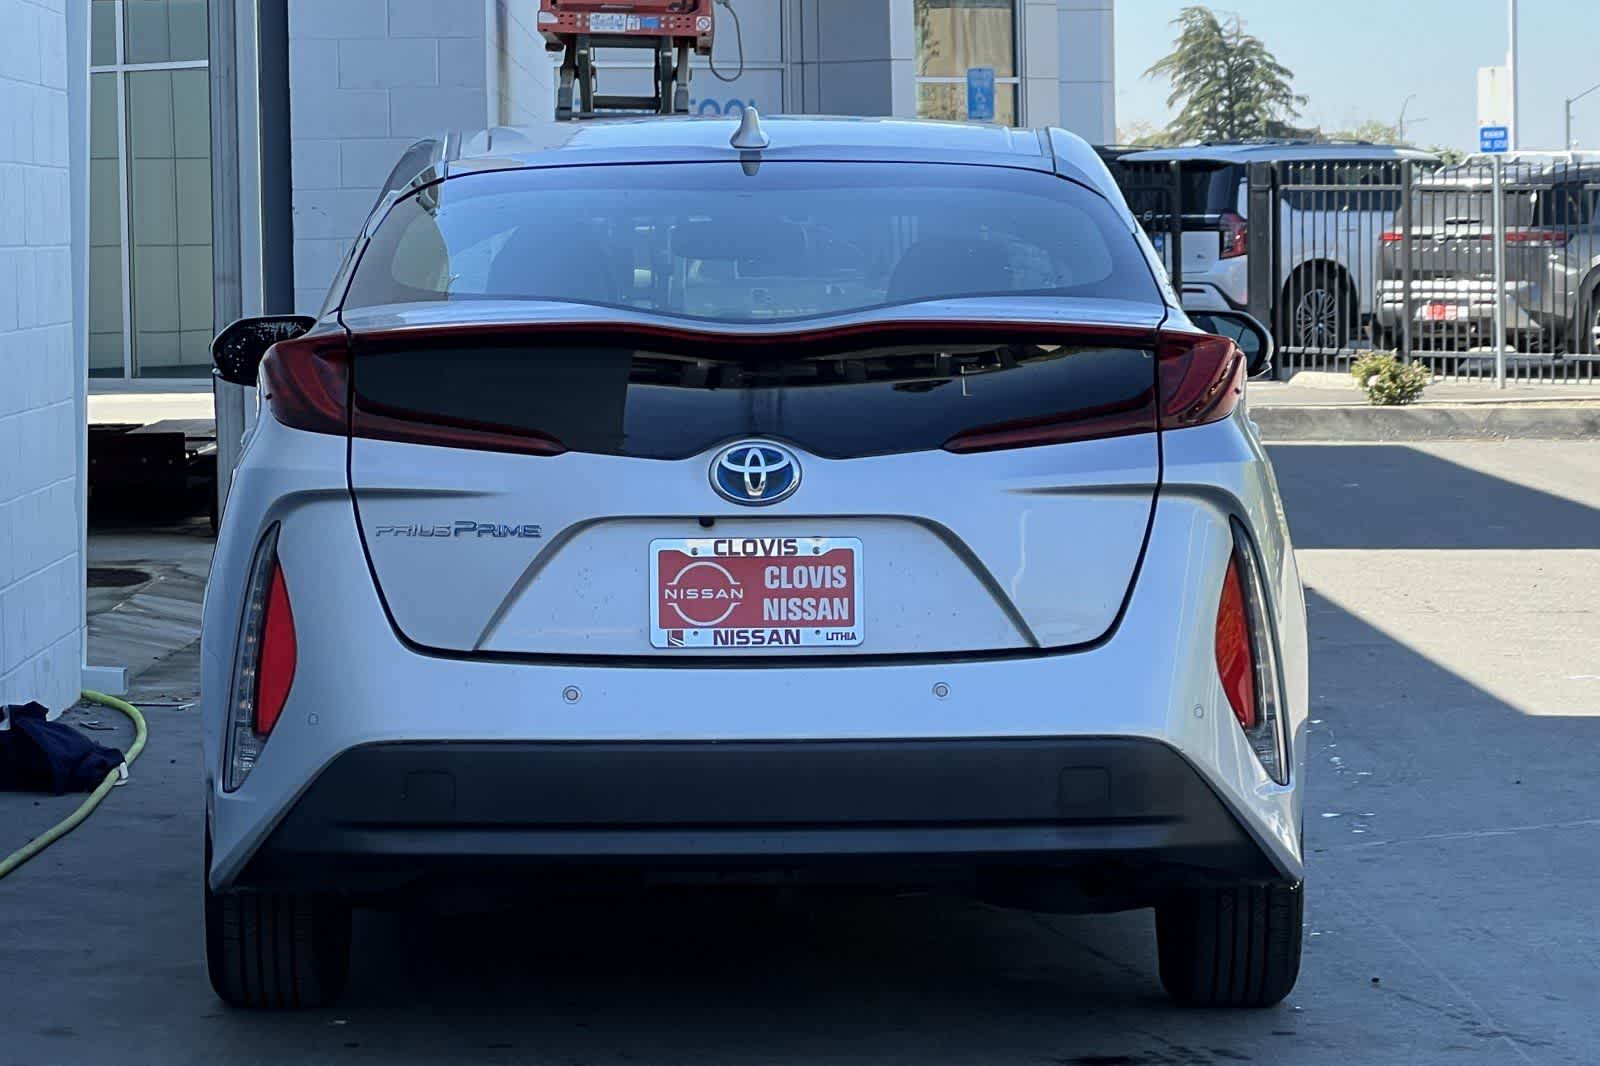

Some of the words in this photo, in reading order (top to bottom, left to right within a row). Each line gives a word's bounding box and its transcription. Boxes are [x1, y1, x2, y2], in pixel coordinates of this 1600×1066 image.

[375, 524, 451, 537] PRIUS
[454, 520, 542, 538] PRIME
[714, 539, 798, 556] CLOVIS
[764, 565, 847, 589] CLOVIS
[664, 588, 744, 600] NISSAN
[763, 597, 849, 621] NISSAN
[713, 629, 801, 646] NISSAN
[826, 631, 857, 641] LITHIA
